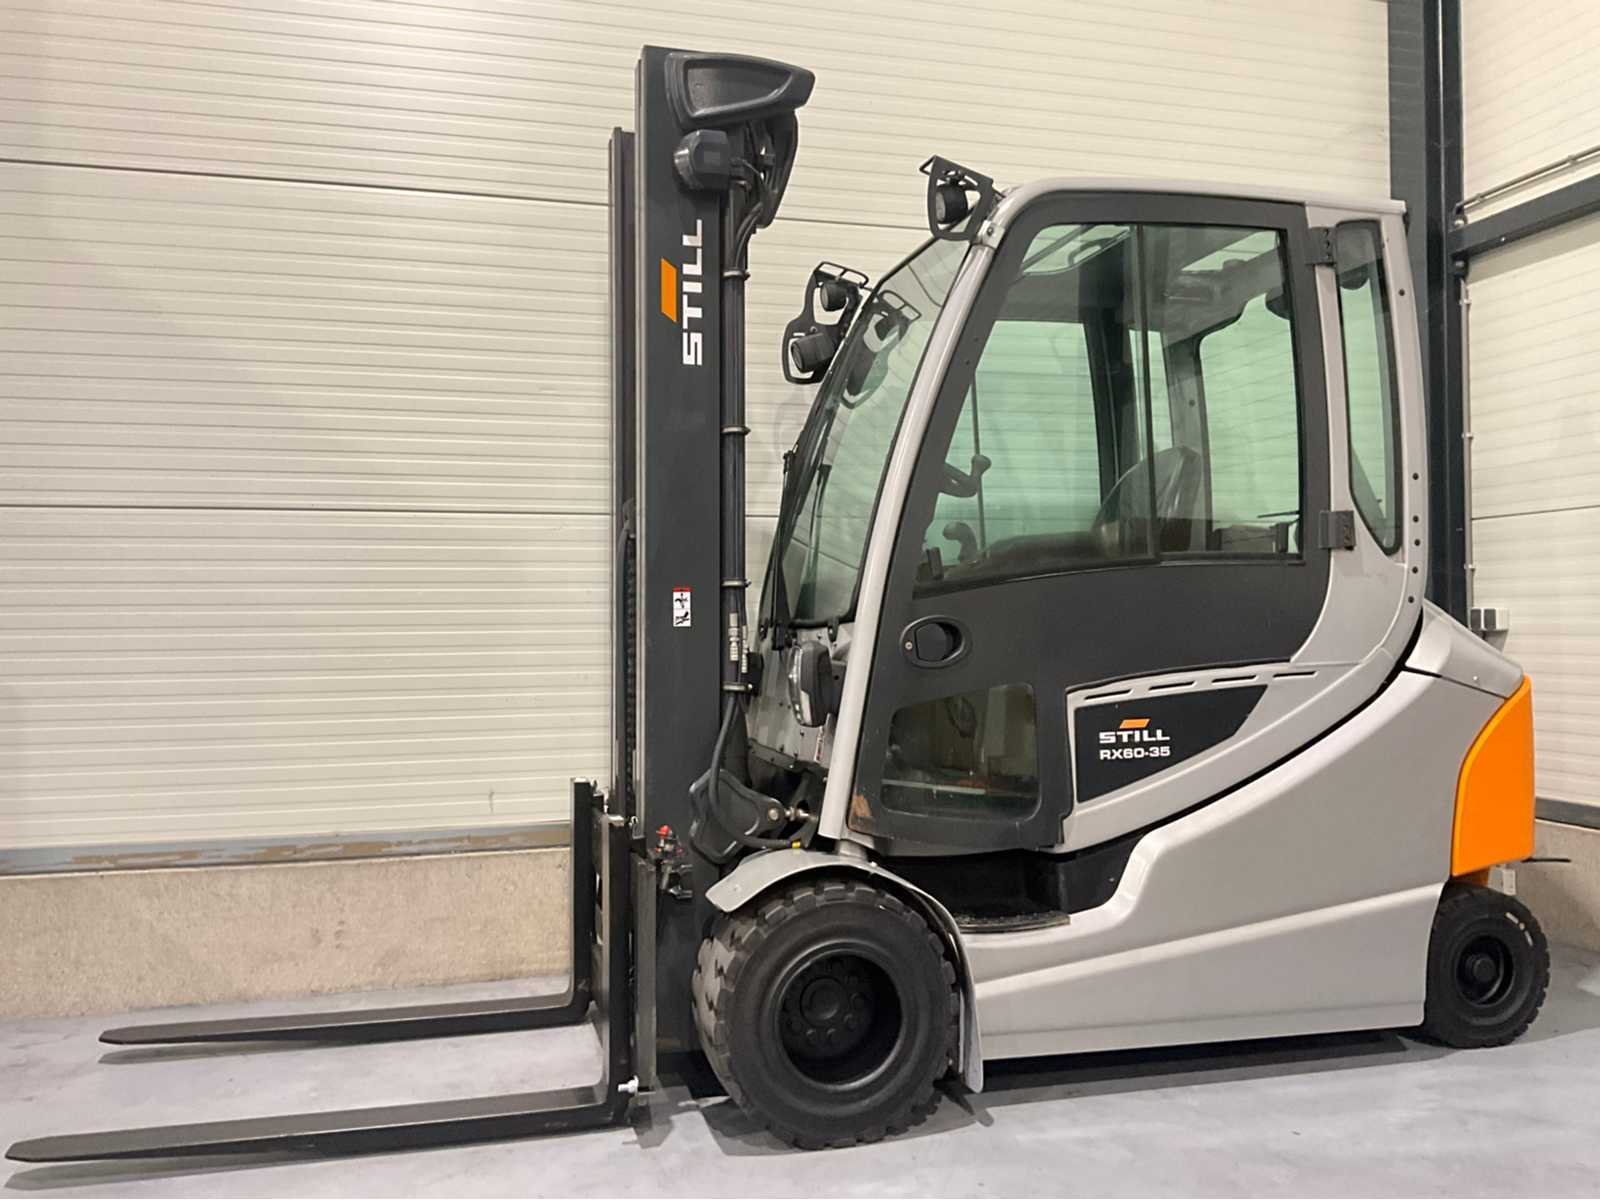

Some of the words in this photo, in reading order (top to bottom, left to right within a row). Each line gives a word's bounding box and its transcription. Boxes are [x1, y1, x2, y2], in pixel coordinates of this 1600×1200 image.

[682, 219, 702, 366] STILL
[1099, 729, 1170, 743] STILL
[1099, 746, 1170, 760] RX60-35
